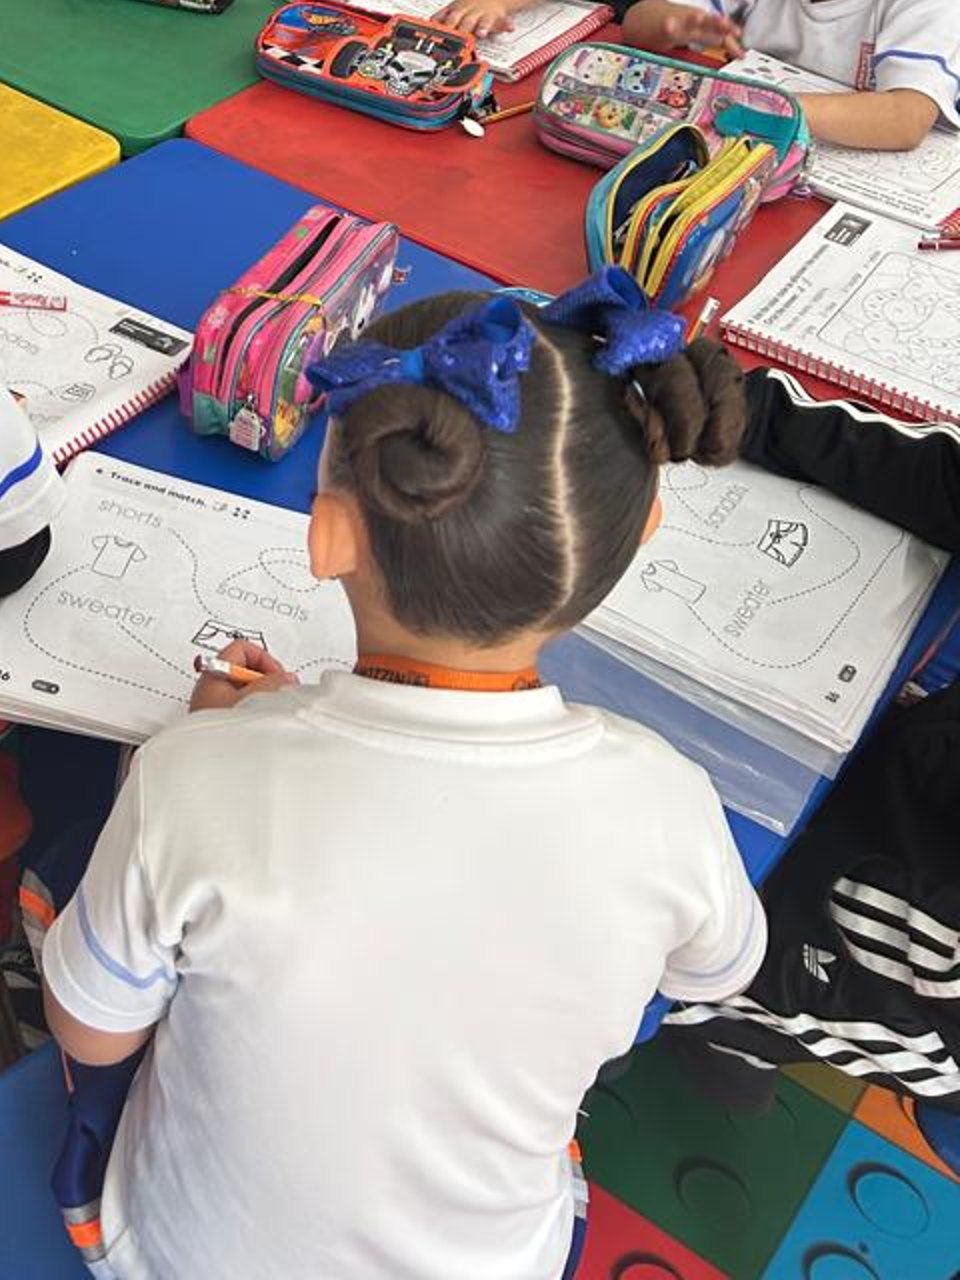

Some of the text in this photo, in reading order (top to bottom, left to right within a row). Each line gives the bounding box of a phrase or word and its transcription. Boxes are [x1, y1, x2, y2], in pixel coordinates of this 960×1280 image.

[109, 471, 207, 508] Trace and match.
[97, 498, 163, 528] shorts
[57, 589, 156, 628] sweater
[216, 581, 309, 623] sandals
[723, 578, 770, 638] sweater
